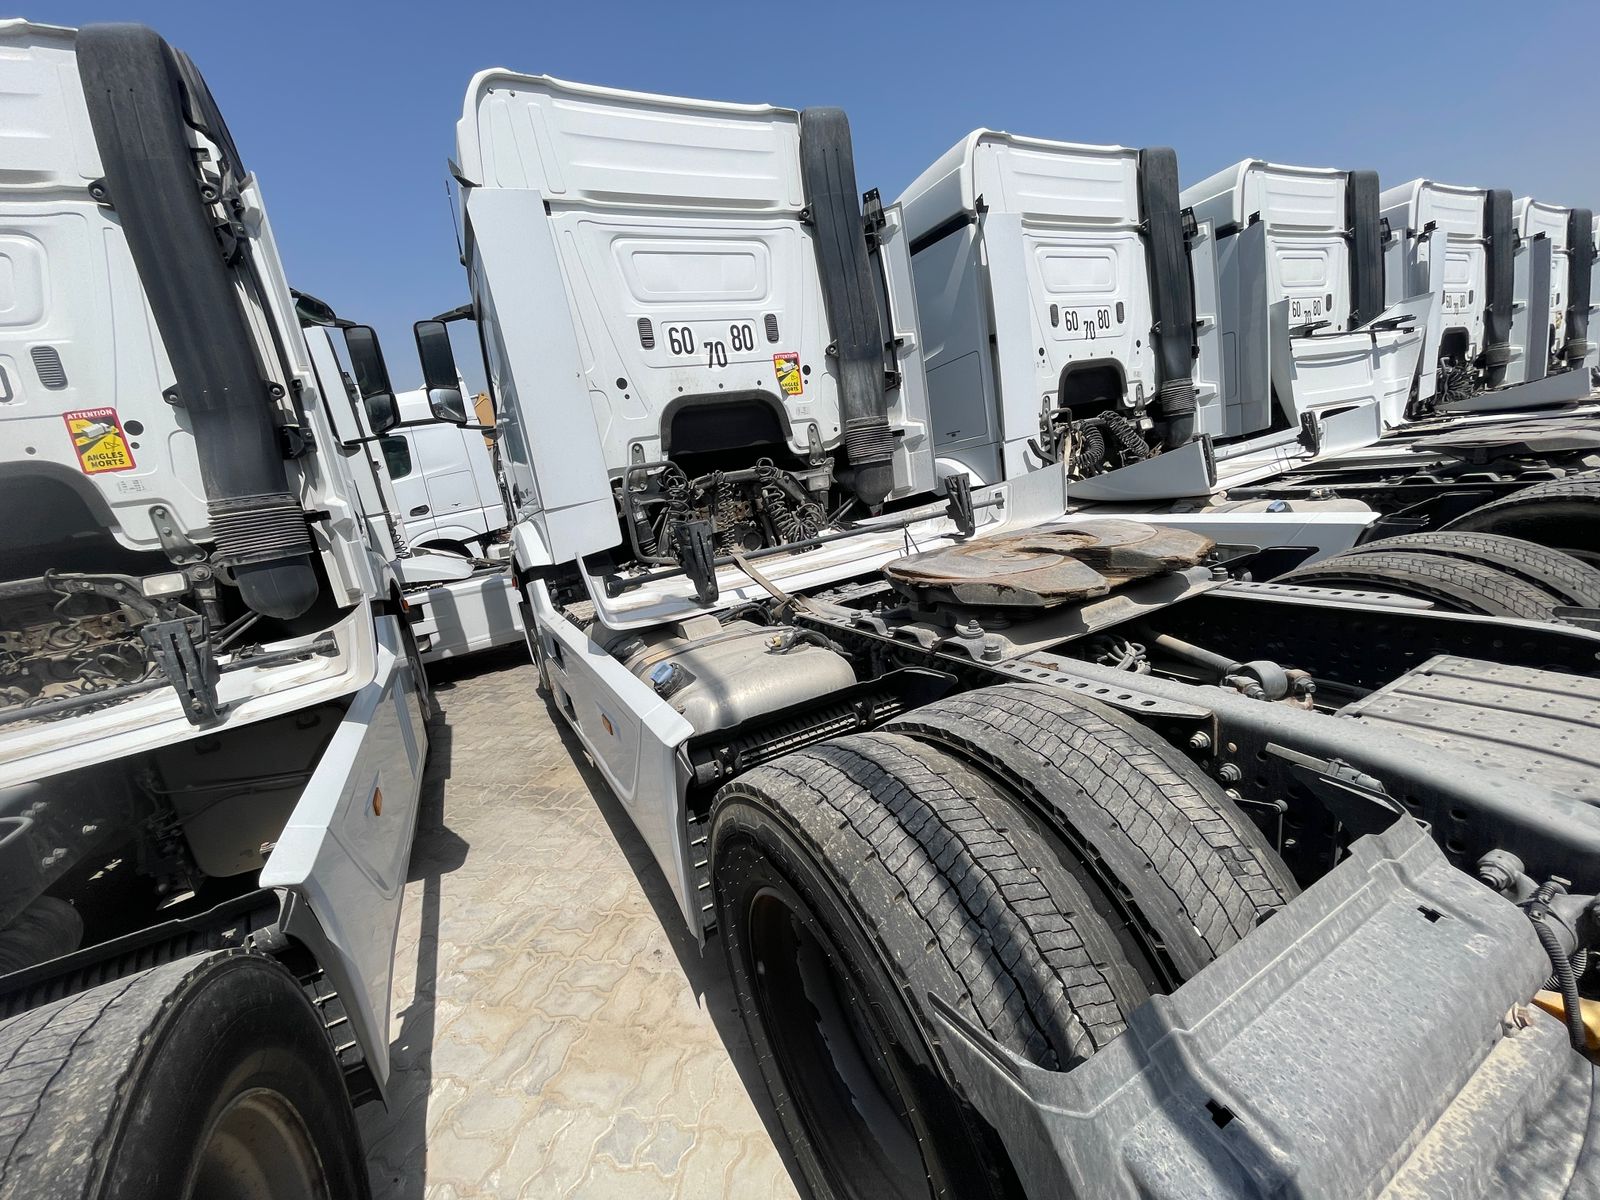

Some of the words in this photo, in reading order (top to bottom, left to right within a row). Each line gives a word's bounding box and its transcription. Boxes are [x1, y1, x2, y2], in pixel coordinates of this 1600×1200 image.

[1292, 301, 1301, 317] 60
[1313, 300, 1321, 316] 80
[1064, 310, 1079, 332] 60
[1097, 309, 1110, 330] 80
[668, 326, 695, 356] 60
[730, 324, 754, 352] 80
[1083, 320, 1096, 341] 70
[703, 341, 728, 369] 70
[67, 408, 113, 420] ATTENTION
[87, 451, 124, 463] ANGLES
[91, 458, 125, 469] MORTS
